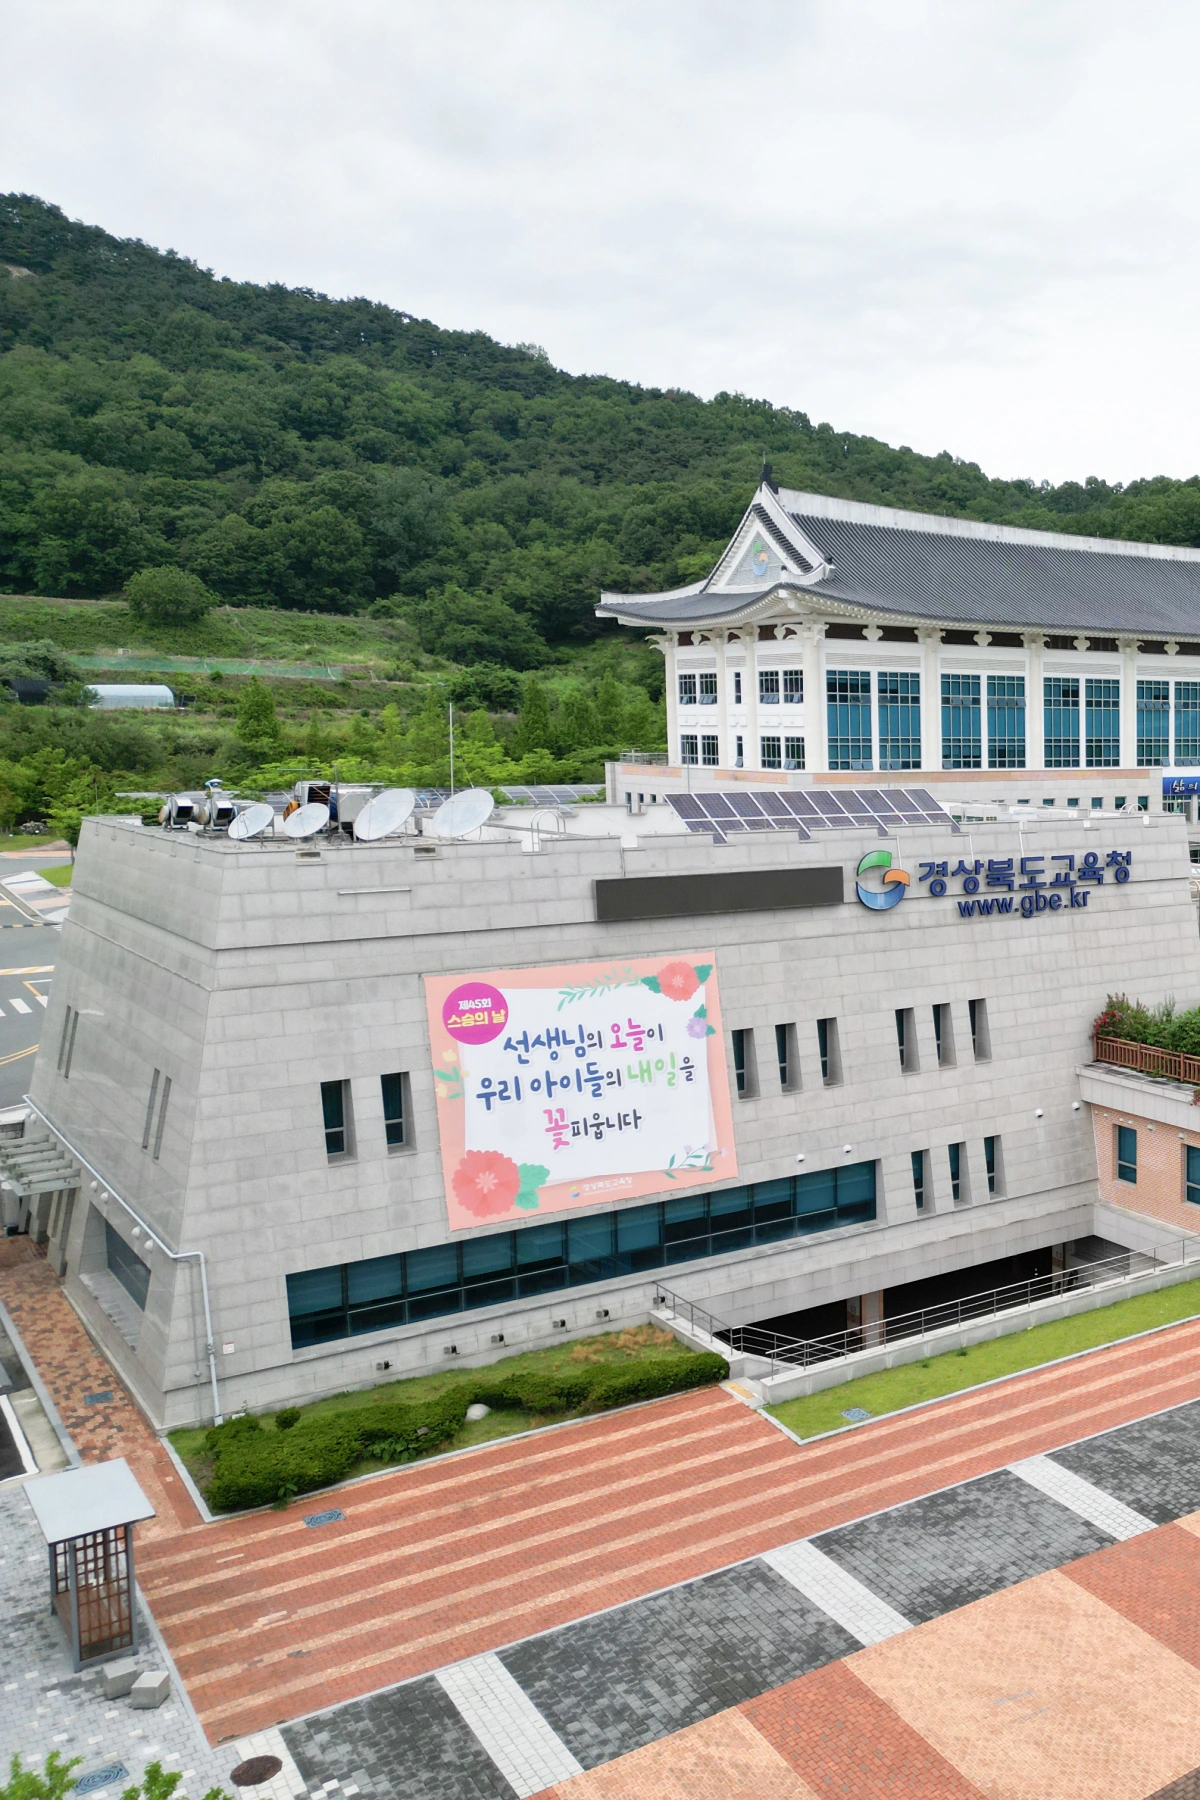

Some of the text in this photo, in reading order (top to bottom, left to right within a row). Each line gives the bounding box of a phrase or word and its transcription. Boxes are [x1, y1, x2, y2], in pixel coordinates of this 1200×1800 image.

[918, 850, 1132, 897] 경상북도교육청
[957, 887, 1091, 919] www.gbe.kr
[447, 1008, 506, 1028] 스승의 날
[457, 997, 492, 1011] 제45회
[502, 1017, 664, 1065] 선생님의 오늘이
[475, 1052, 695, 1111] 우리 아이들의 내일을
[542, 1108, 643, 1151] 꽃피웁니다
